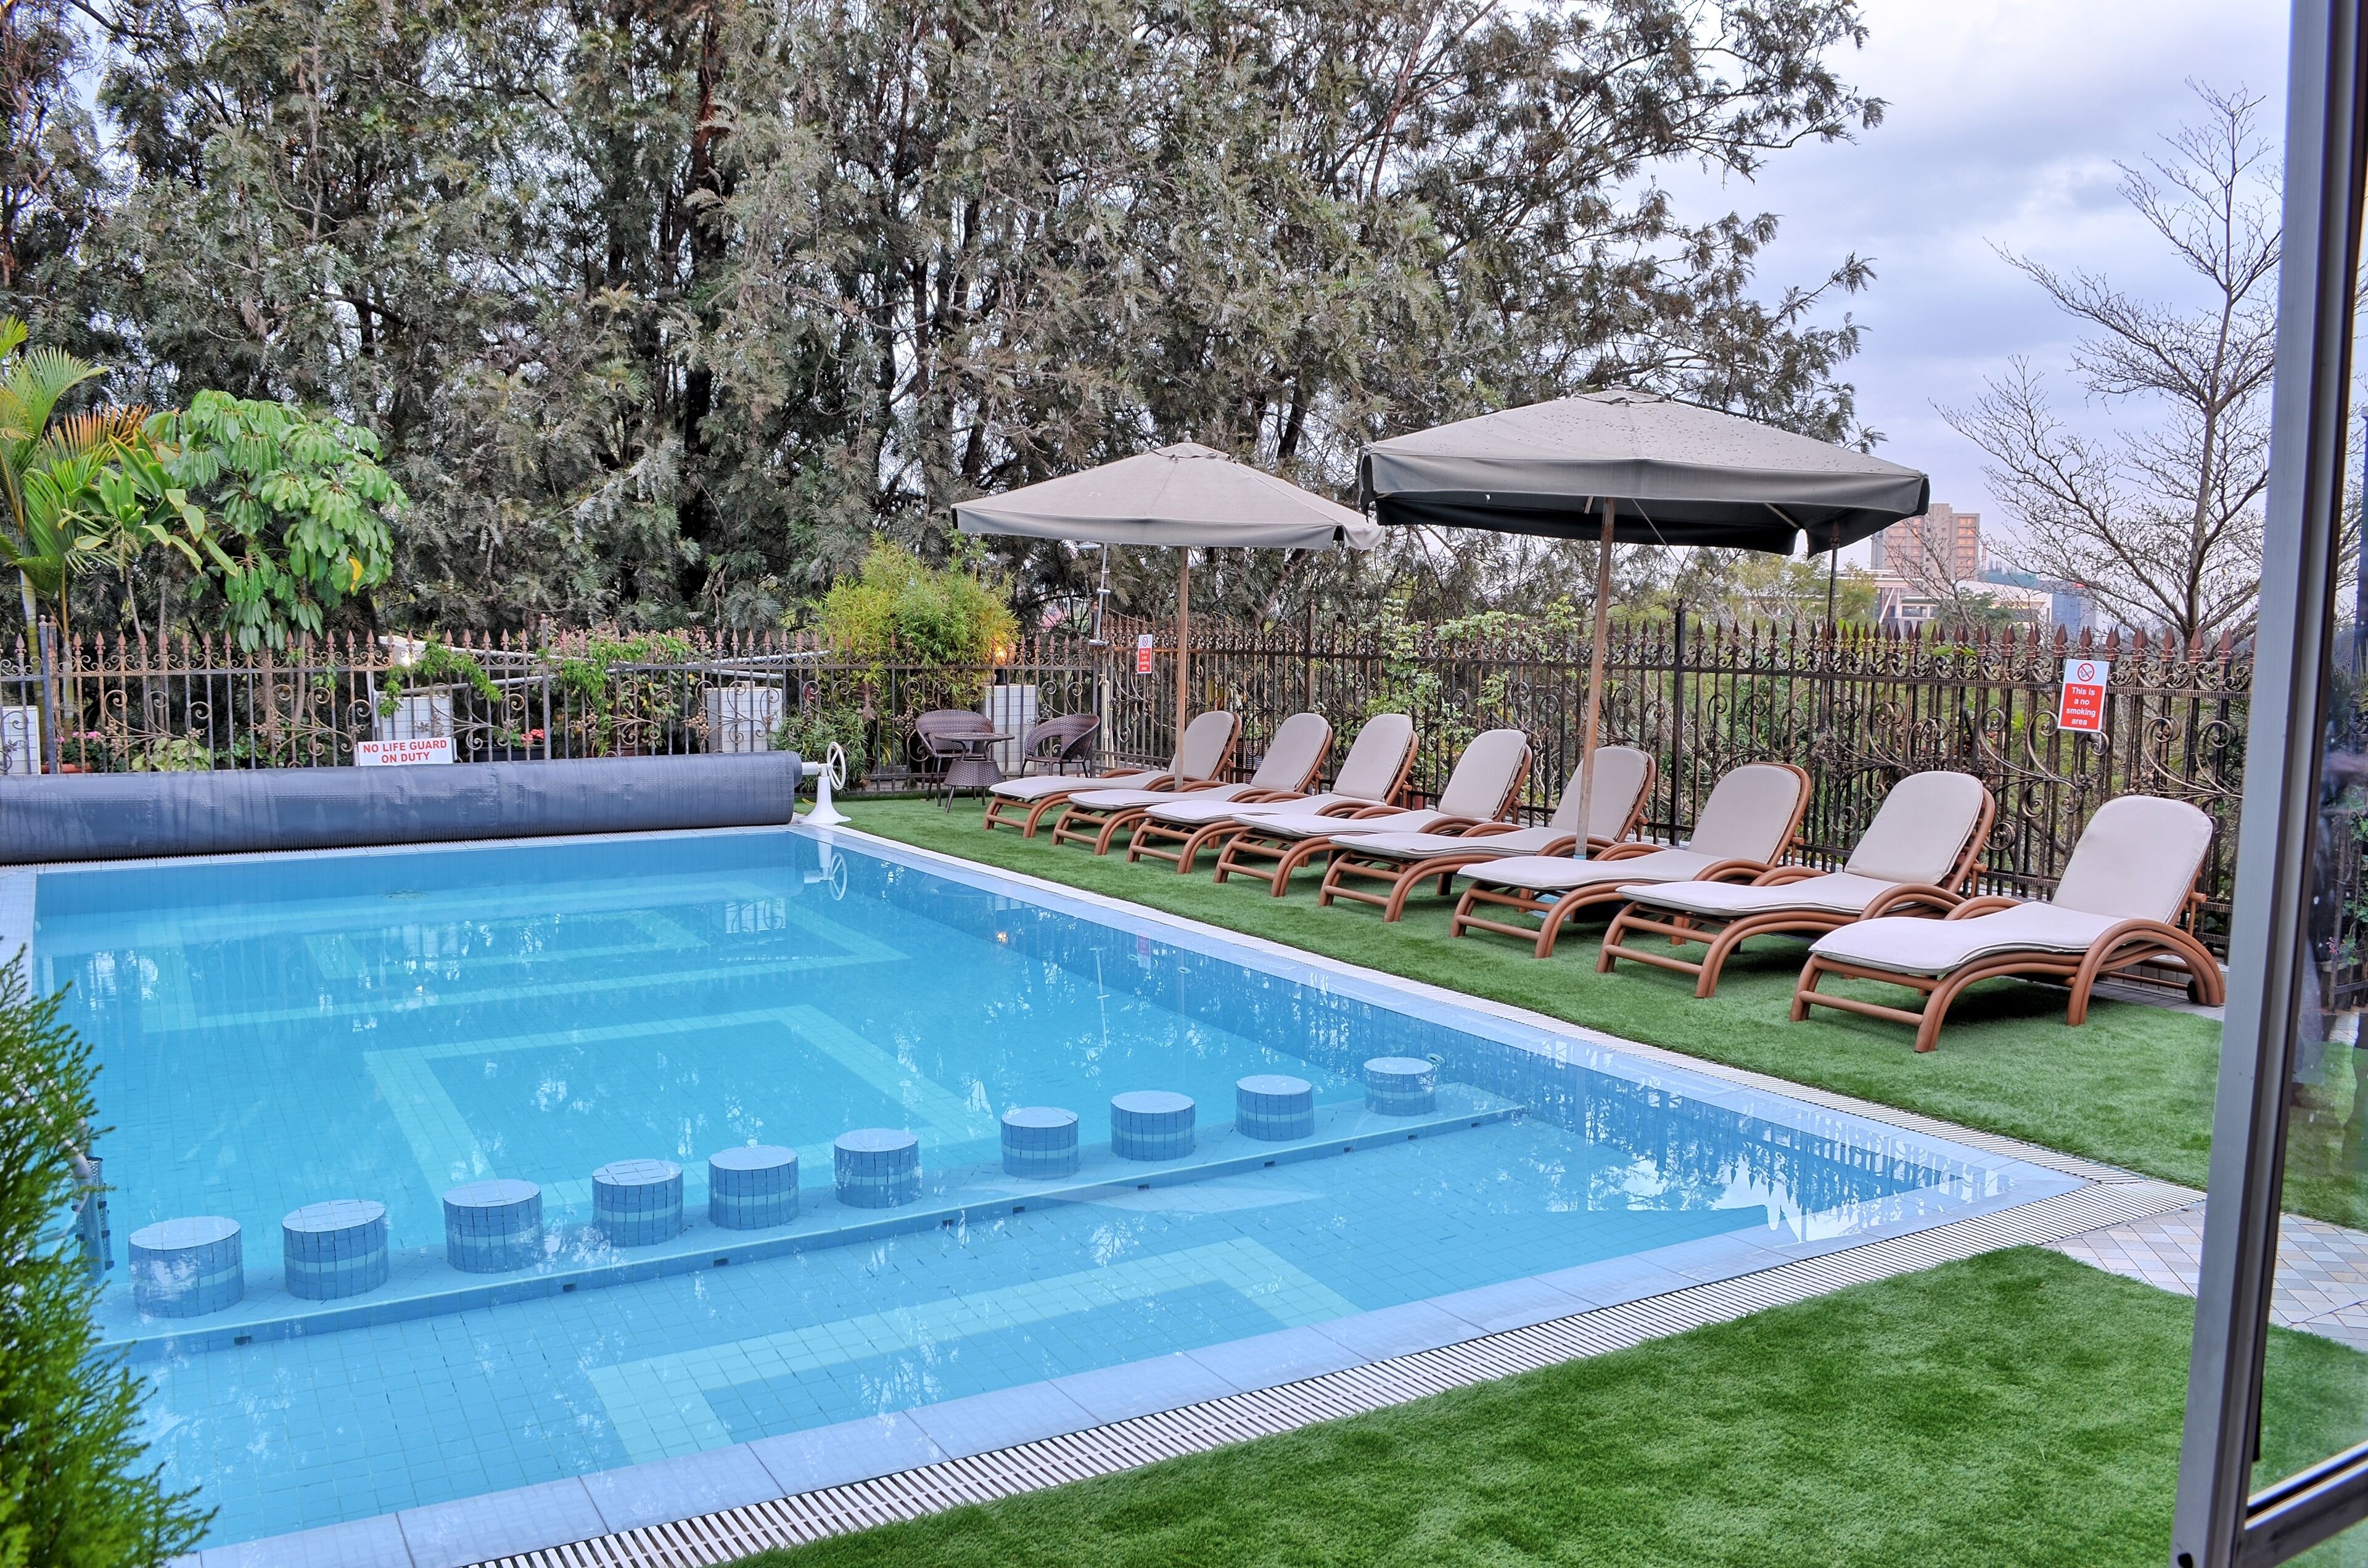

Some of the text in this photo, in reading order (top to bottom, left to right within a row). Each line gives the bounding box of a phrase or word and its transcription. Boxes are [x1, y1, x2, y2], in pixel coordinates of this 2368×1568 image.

[2072, 687, 2095, 696] This is
[2066, 708, 2096, 718] smoking
[363, 740, 447, 753] NO LIFE GUARD
[381, 752, 430, 763] ON DUTY
